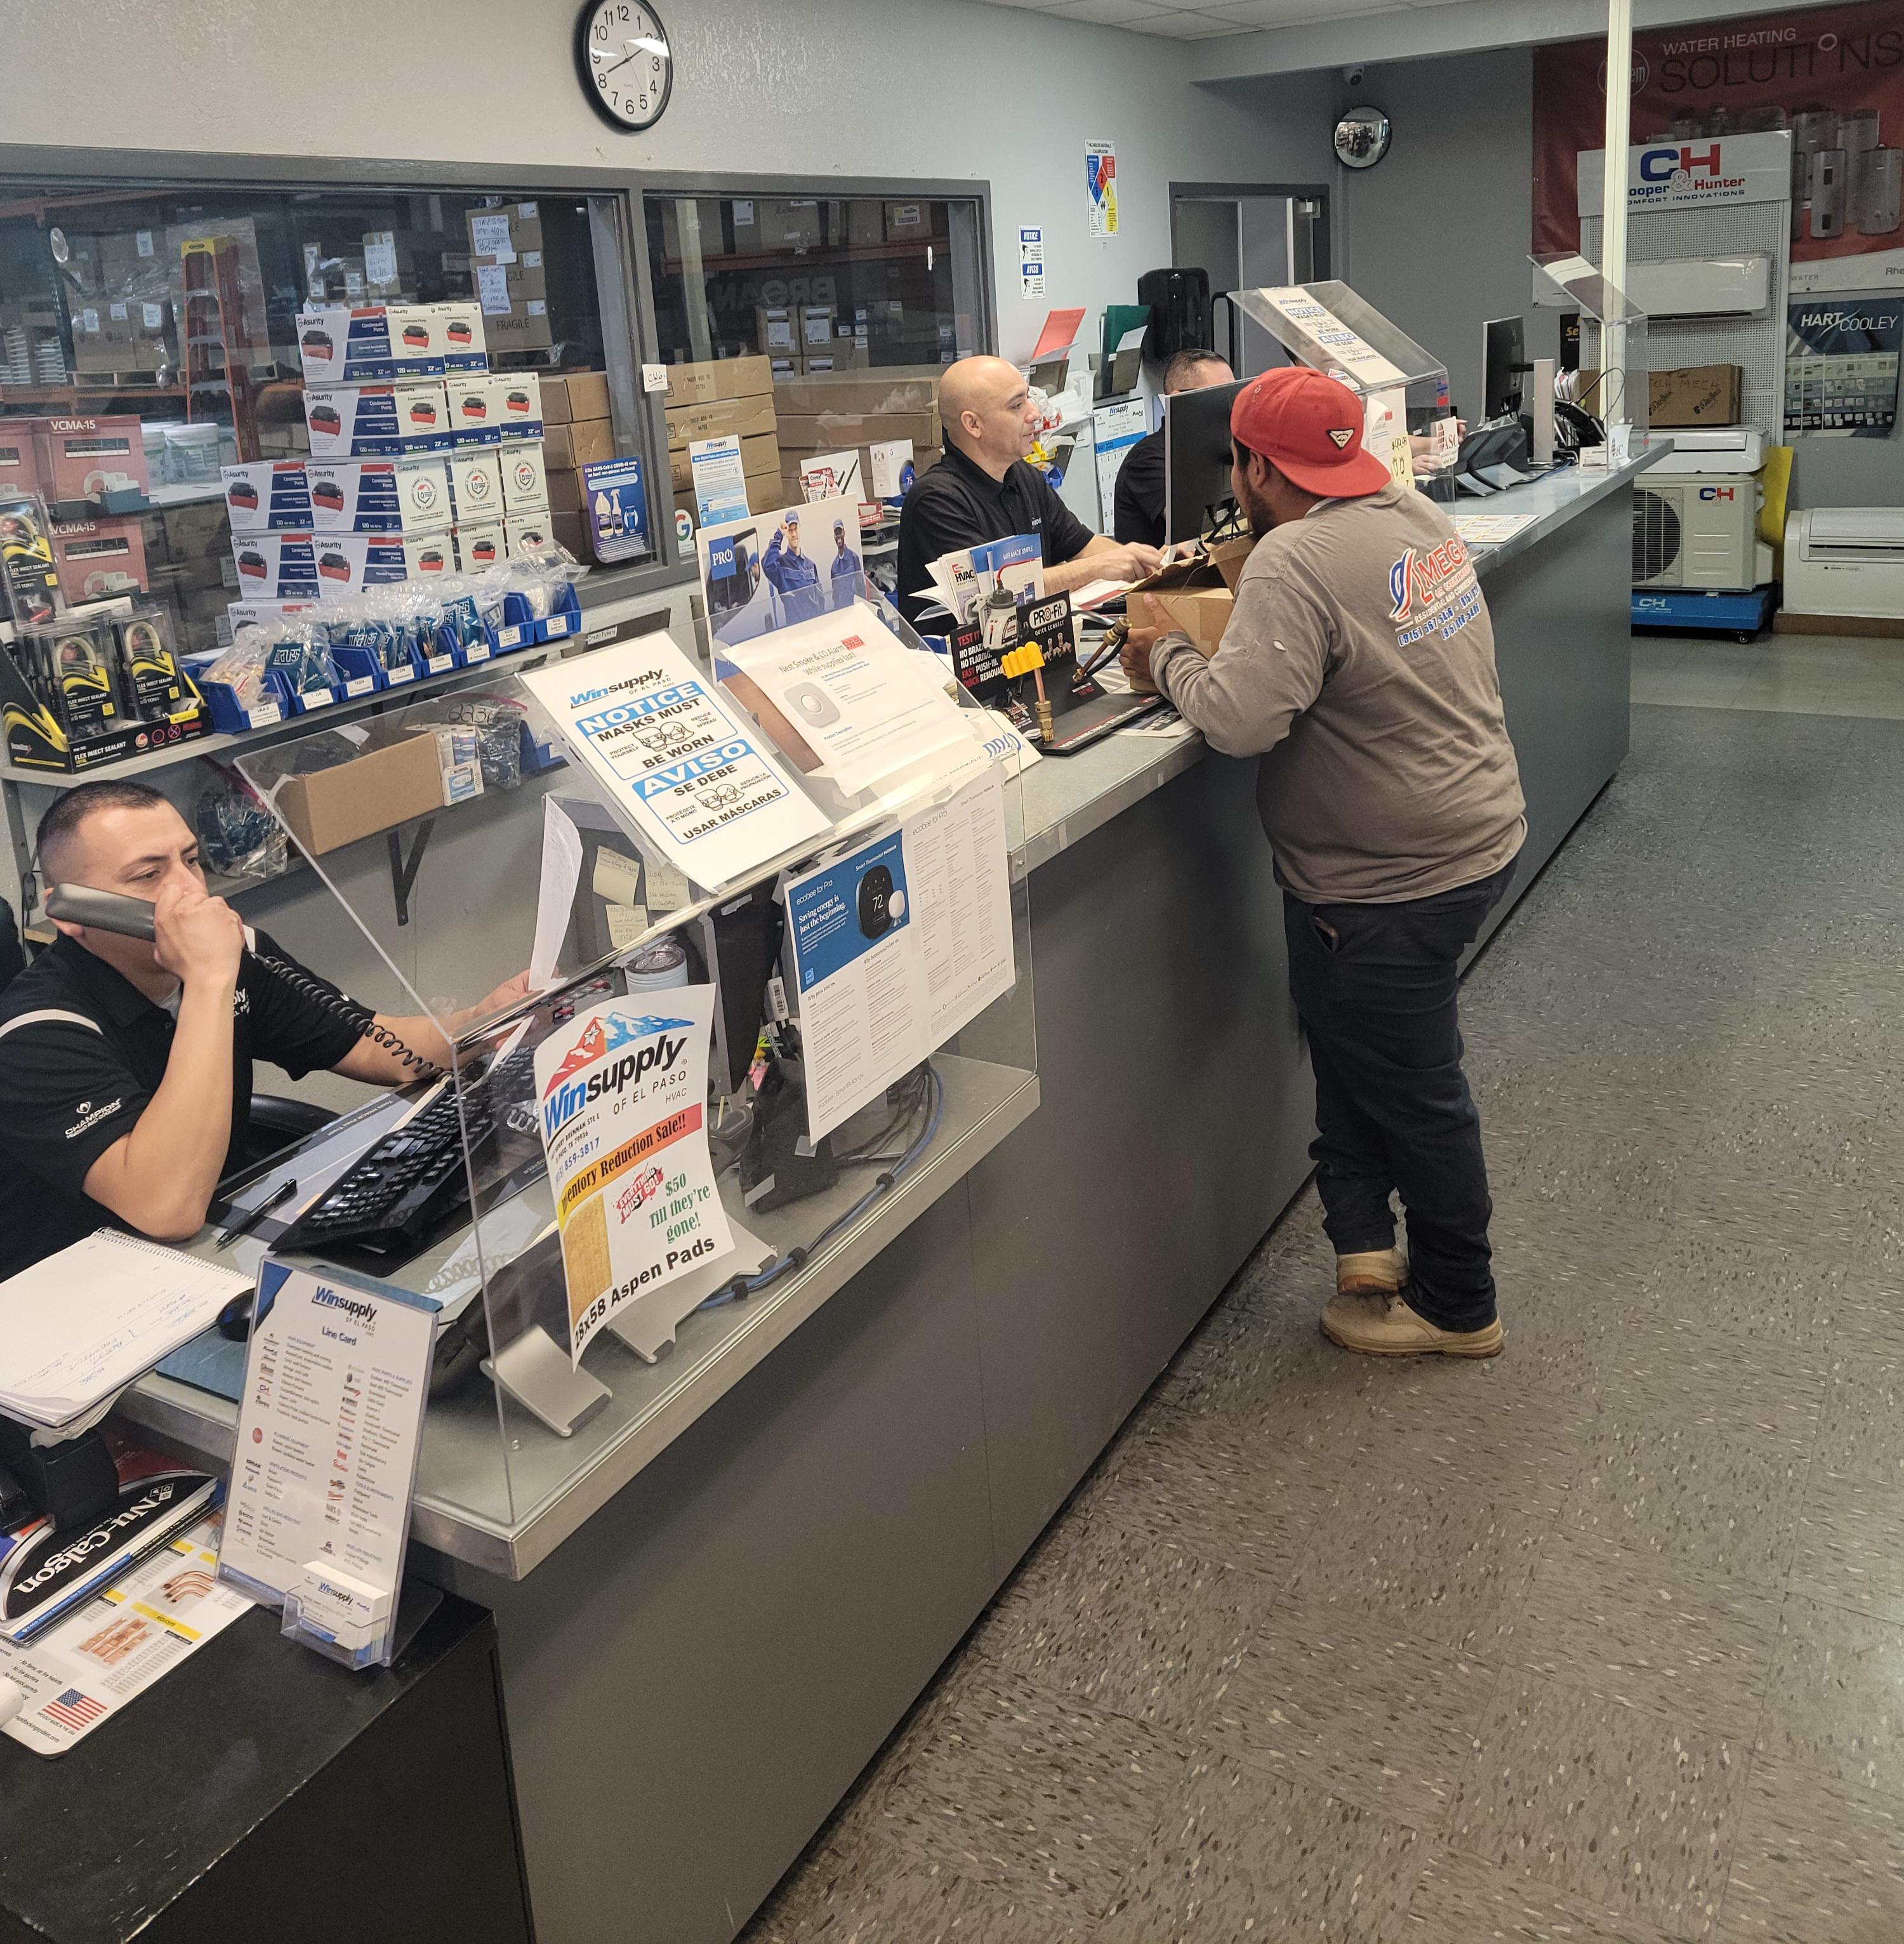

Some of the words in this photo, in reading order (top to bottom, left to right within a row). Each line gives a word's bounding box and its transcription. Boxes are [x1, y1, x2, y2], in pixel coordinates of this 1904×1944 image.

[604, 10, 613, 25] 11
[617, 5, 630, 21] 12
[637, 15, 641, 30] 1
[594, 25, 607, 40] 10
[1663, 37, 1719, 56] WATER
[1723, 28, 1796, 49] HEATING
[652, 56, 659, 71] 3
[598, 74, 607, 88] 8
[650, 80, 657, 94] 4
[611, 91, 618, 106] 7
[639, 94, 647, 110] 5
[626, 100, 634, 114] 6
[1641, 144, 1721, 182] CH
[1628, 184, 1670, 197] ooper
[1695, 178, 1745, 190] Hunter
[1673, 190, 1745, 201] INNOVATIONS
[1024, 232, 1038, 241] NOTICE
[1027, 265, 1039, 274] AVISO
[1288, 307, 1324, 315] NOTICE
[303, 317, 324, 326] Asurity
[496, 319, 529, 330] FRAGILE
[1801, 312, 1843, 327] HART
[1840, 315, 1898, 331] COOLEY
[1322, 334, 1354, 343] AVISO
[312, 393, 333, 401] Asurity
[1109, 404, 1128, 414] Winsupply
[50, 420, 96, 432] VCMA-15
[228, 469, 249, 477] Asurity
[314, 469, 334, 479] Asurity
[906, 477, 913, 486] 75
[1699, 487, 1734, 501] CH
[50, 522, 96, 535] VCMA-15
[237, 539, 258, 548] Asurity
[319, 541, 341, 550] Asurity
[712, 548, 732, 566] PRO
[955, 569, 975, 583] HVAC
[1639, 598, 1666, 607] CH
[236, 608, 256, 617] Asurity
[1035, 627, 1047, 636] QUICK
[1048, 620, 1064, 631] CONNECT
[957, 632, 973, 646] TEST
[778, 663, 795, 673] Nest
[793, 656, 814, 668] Smoke
[818, 650, 828, 659] CO
[828, 645, 845, 655] Alarm
[959, 649, 967, 659] NO
[961, 659, 969, 669] NO
[969, 651, 993, 665] FLARING.
[803, 665, 823, 675] While
[821, 658, 844, 670] supplies
[843, 651, 857, 660] last!
[962, 666, 975, 678] EASY
[975, 658, 998, 673] PUSH-IN.
[570, 669, 663, 706] Winsupply
[653, 677, 671, 687] PASO
[580, 683, 699, 734] NOTICE
[597, 716, 656, 742] MASKS
[658, 698, 700, 718] MUST
[691, 712, 711, 722] REDUCE
[696, 718, 717, 728] SPREAD
[88, 748, 103, 758] INJECT
[105, 741, 126, 752] SEALANT
[609, 743, 635, 755] PROTECT
[610, 746, 639, 760] YOURSELF
[642, 754, 666, 769] BE
[666, 734, 715, 758] WORN
[644, 743, 746, 796] AVISO
[674, 783, 696, 796] SE
[697, 765, 737, 786] DEBE
[740, 775, 760, 786] REDUCIR
[680, 809, 697, 818] MISMO
[683, 819, 719, 839] USAR
[718, 789, 781, 823] MÁSCARAS
[913, 821, 932, 835] ecobee
[939, 810, 948, 819] Pro
[866, 852, 883, 866] Thermostat
[797, 889, 817, 905] ecobee
[824, 880, 833, 890] Pro
[798, 908, 817, 923] Saving
[817, 897, 834, 913] energy
[834, 894, 840, 903] is
[872, 894, 883, 912] 72
[800, 923, 810, 936] just
[810, 918, 819, 927] the
[819, 902, 846, 920] beginning.
[544, 1035, 687, 1141] Winsupply
[613, 1098, 627, 1114] OF
[633, 1088, 646, 1104] EL
[652, 1071, 687, 1093] PASO
[666, 1087, 687, 1104] HVAC
[65, 1102, 119, 1135] CHAMPION
[565, 1121, 586, 1140] BRENNAN
[587, 1116, 596, 1125] STE
[564, 1137, 600, 1170] 859-3817
[562, 1168, 597, 1215] Inventory
[600, 1137, 653, 1178] Reduction
[656, 1114, 686, 1142] Sale!!
[618, 1167, 657, 1207] EVERYTHING
[665, 1173, 686, 1197] $50
[622, 1192, 645, 1220] MUST
[644, 1174, 659, 1193] GO!
[649, 1206, 668, 1229] Till
[670, 1185, 710, 1217] they're
[666, 1212, 701, 1244] gone!
[574, 1299, 606, 1351] 28x58
[611, 1264, 662, 1307] Aspen
[666, 1238, 715, 1271] Pads
[315, 1286, 378, 1322] Winsupply
[322, 1326, 337, 1339] Line
[339, 1333, 357, 1346] Card
[13, 1497, 161, 1593] Nu-Calgon
[320, 1582, 354, 1606] Winsupply
